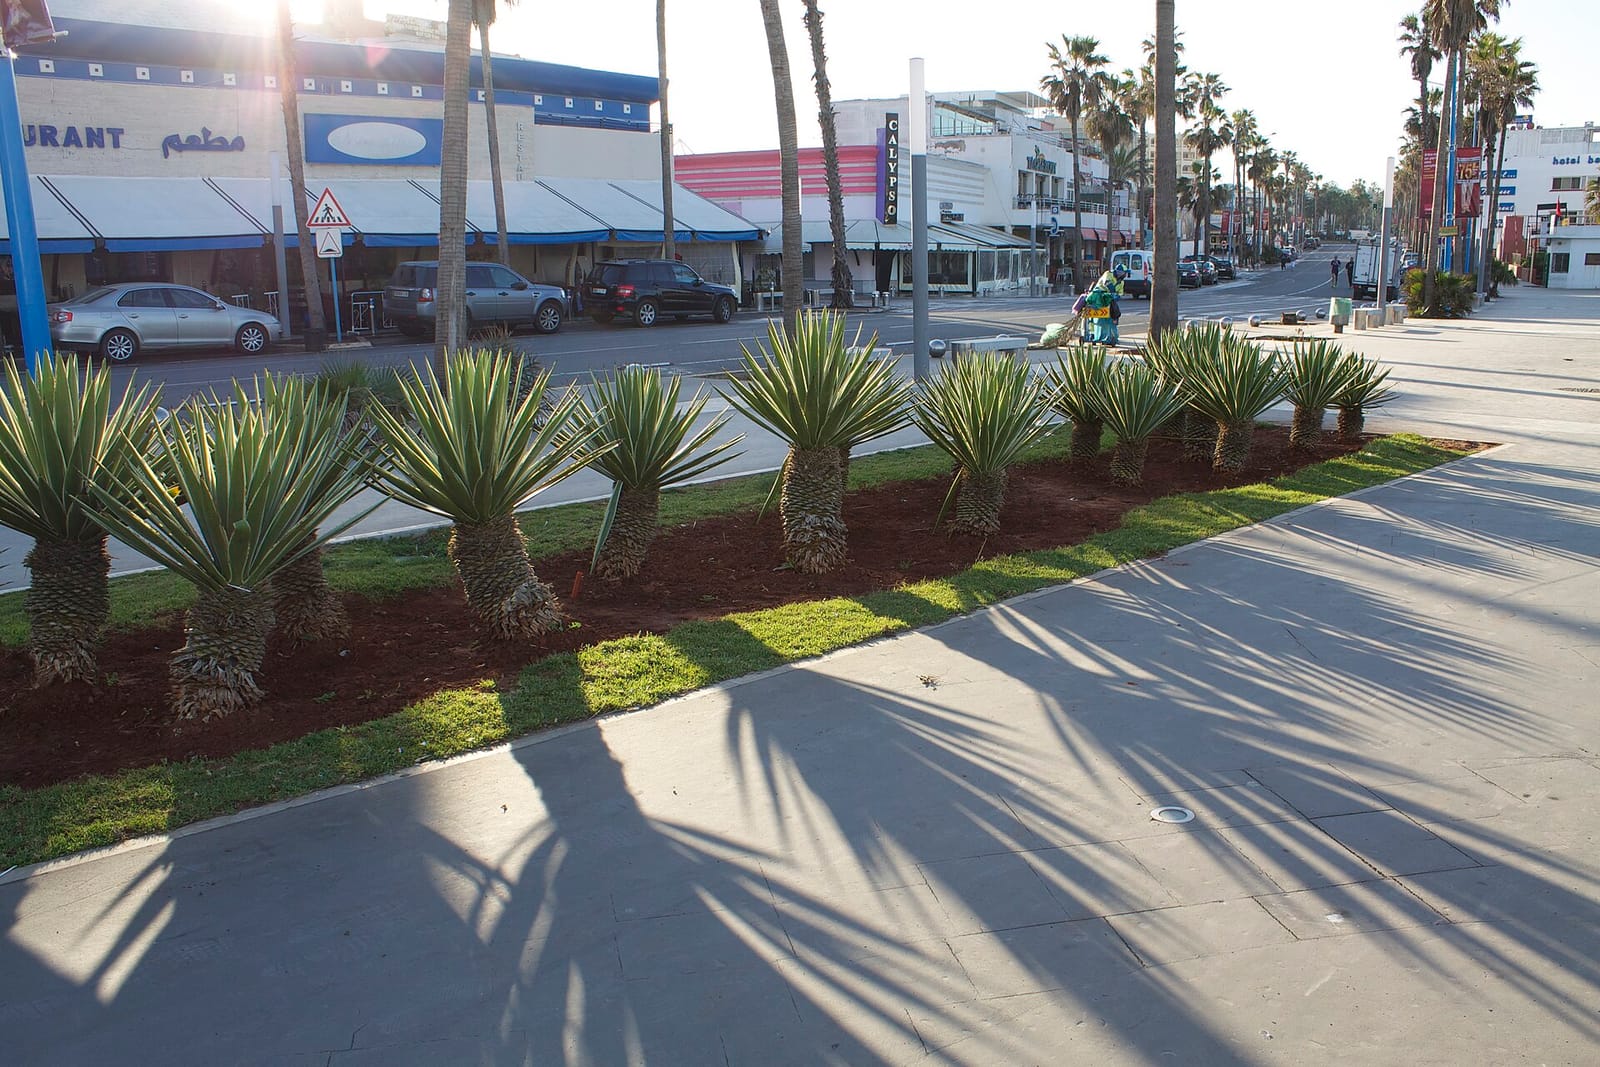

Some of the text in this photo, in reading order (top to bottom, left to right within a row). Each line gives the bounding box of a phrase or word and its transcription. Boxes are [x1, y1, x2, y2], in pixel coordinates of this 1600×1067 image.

[161, 127, 246, 159] مطعم
[888, 119, 898, 216] CALYPSO
[1552, 155, 1581, 166] hotel
